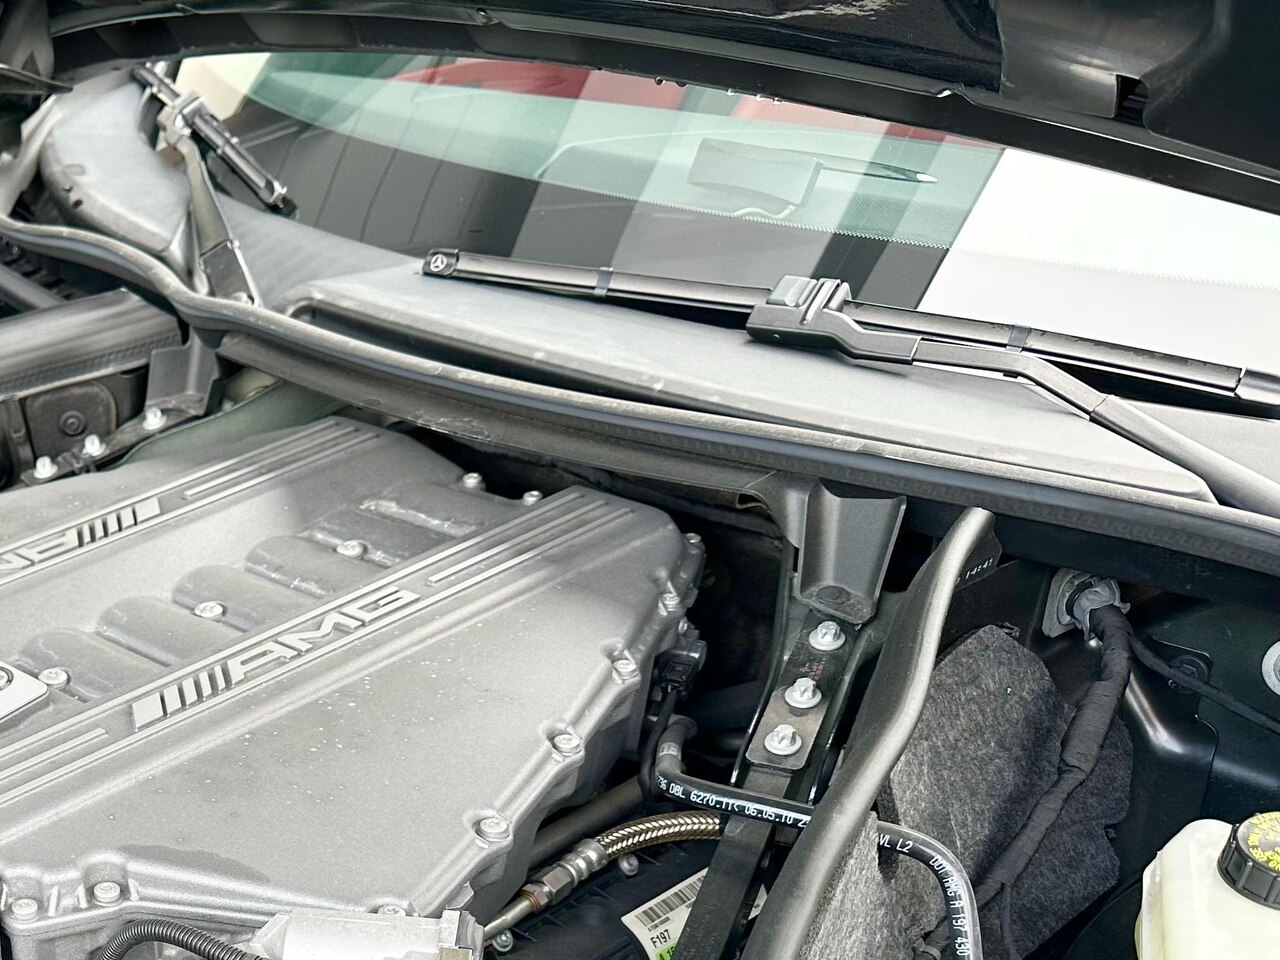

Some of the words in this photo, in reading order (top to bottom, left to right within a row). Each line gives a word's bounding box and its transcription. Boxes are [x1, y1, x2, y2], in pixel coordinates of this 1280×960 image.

[228, 585, 421, 686] AMG
[669, 783, 686, 798] DBL
[896, 838, 914, 853] L2
[950, 900, 964, 908] A
[952, 913, 968, 931] 197
[650, 929, 671, 949] F197
[955, 936, 970, 956] 430
